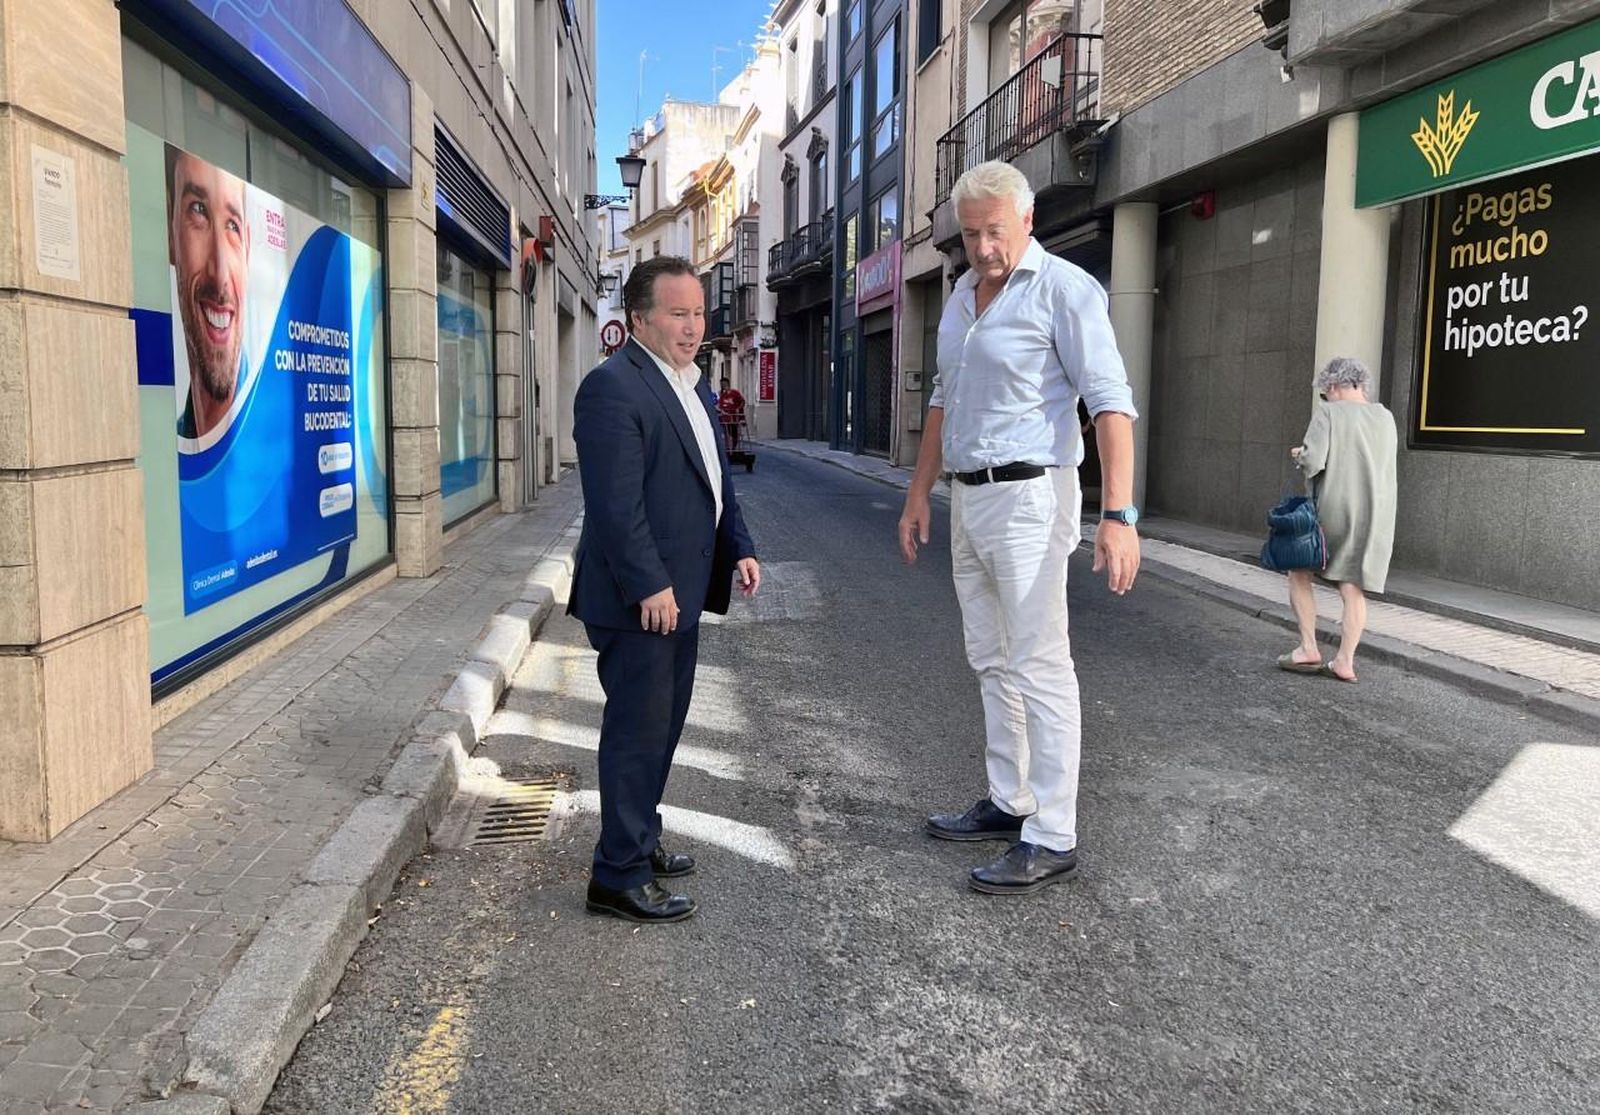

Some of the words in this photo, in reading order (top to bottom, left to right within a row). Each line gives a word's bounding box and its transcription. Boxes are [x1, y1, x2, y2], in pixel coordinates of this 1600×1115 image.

[1451, 182, 1553, 236] ¿Pagas
[1450, 225, 1548, 269] mucho
[1446, 280, 1494, 319] por
[1499, 272, 1529, 304] tu
[287, 319, 350, 350] COMPROMETIDOS
[1444, 305, 1589, 358] hipoteca?
[274, 349, 295, 371] CON
[295, 351, 307, 373] LA
[306, 352, 350, 376] PREVENCIÓN
[307, 382, 318, 402] DE
[318, 383, 329, 402] TU
[329, 384, 351, 403] SALUD
